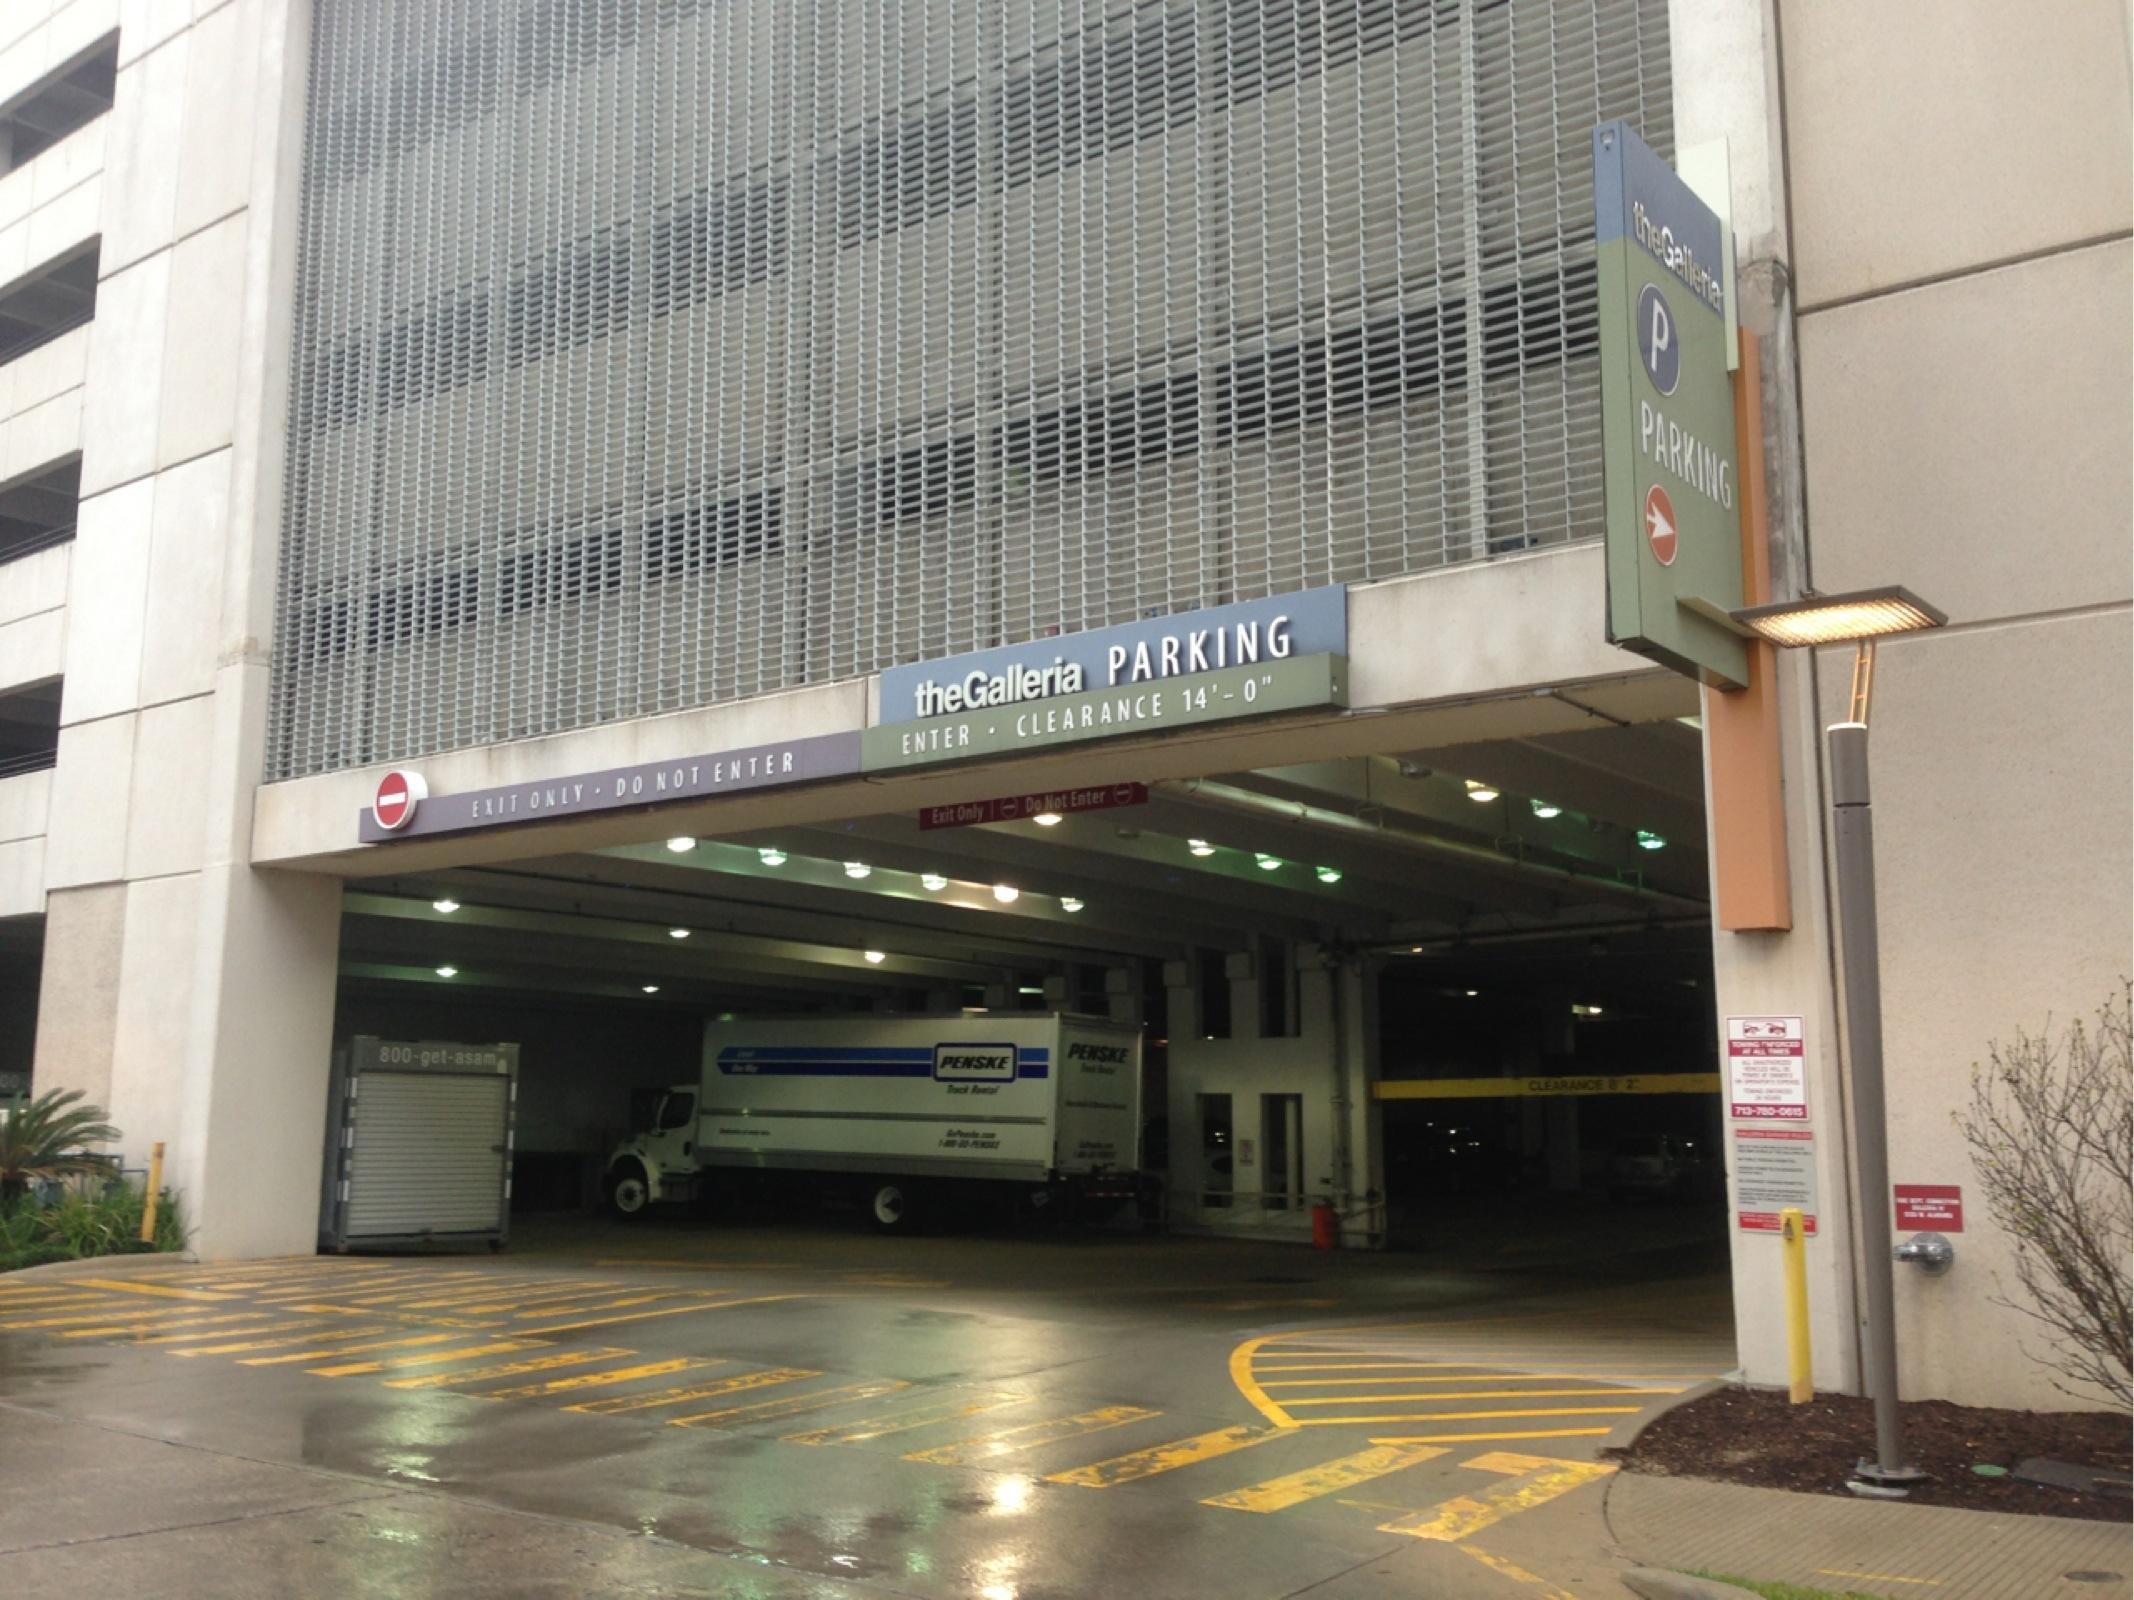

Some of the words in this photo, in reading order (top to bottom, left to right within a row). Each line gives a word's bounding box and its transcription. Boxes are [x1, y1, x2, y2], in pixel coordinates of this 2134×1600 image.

[1651, 298, 1669, 372] P
[1641, 400, 1732, 511] PARKING
[914, 656, 1084, 718] theGalleria
[1108, 615, 1290, 686] PARKING
[902, 725, 969, 754] ENTER
[1017, 692, 1162, 737] CLEARANCE
[472, 794, 518, 818] EXIT
[530, 784, 583, 809] ONLY
[616, 776, 643, 798] DO
[656, 766, 699, 791] NOT
[714, 752, 793, 783] ENTER
[932, 806, 954, 824] Exit
[957, 804, 984, 823] Only
[1025, 796, 1042, 813] Do
[1044, 794, 1067, 809] Not
[1071, 790, 1106, 808] Enter
[939, 1055, 1011, 1070] PENSKE
[1067, 1043, 1130, 1064] PENSKE
[1528, 1079, 1604, 1091] CLEARANCE
